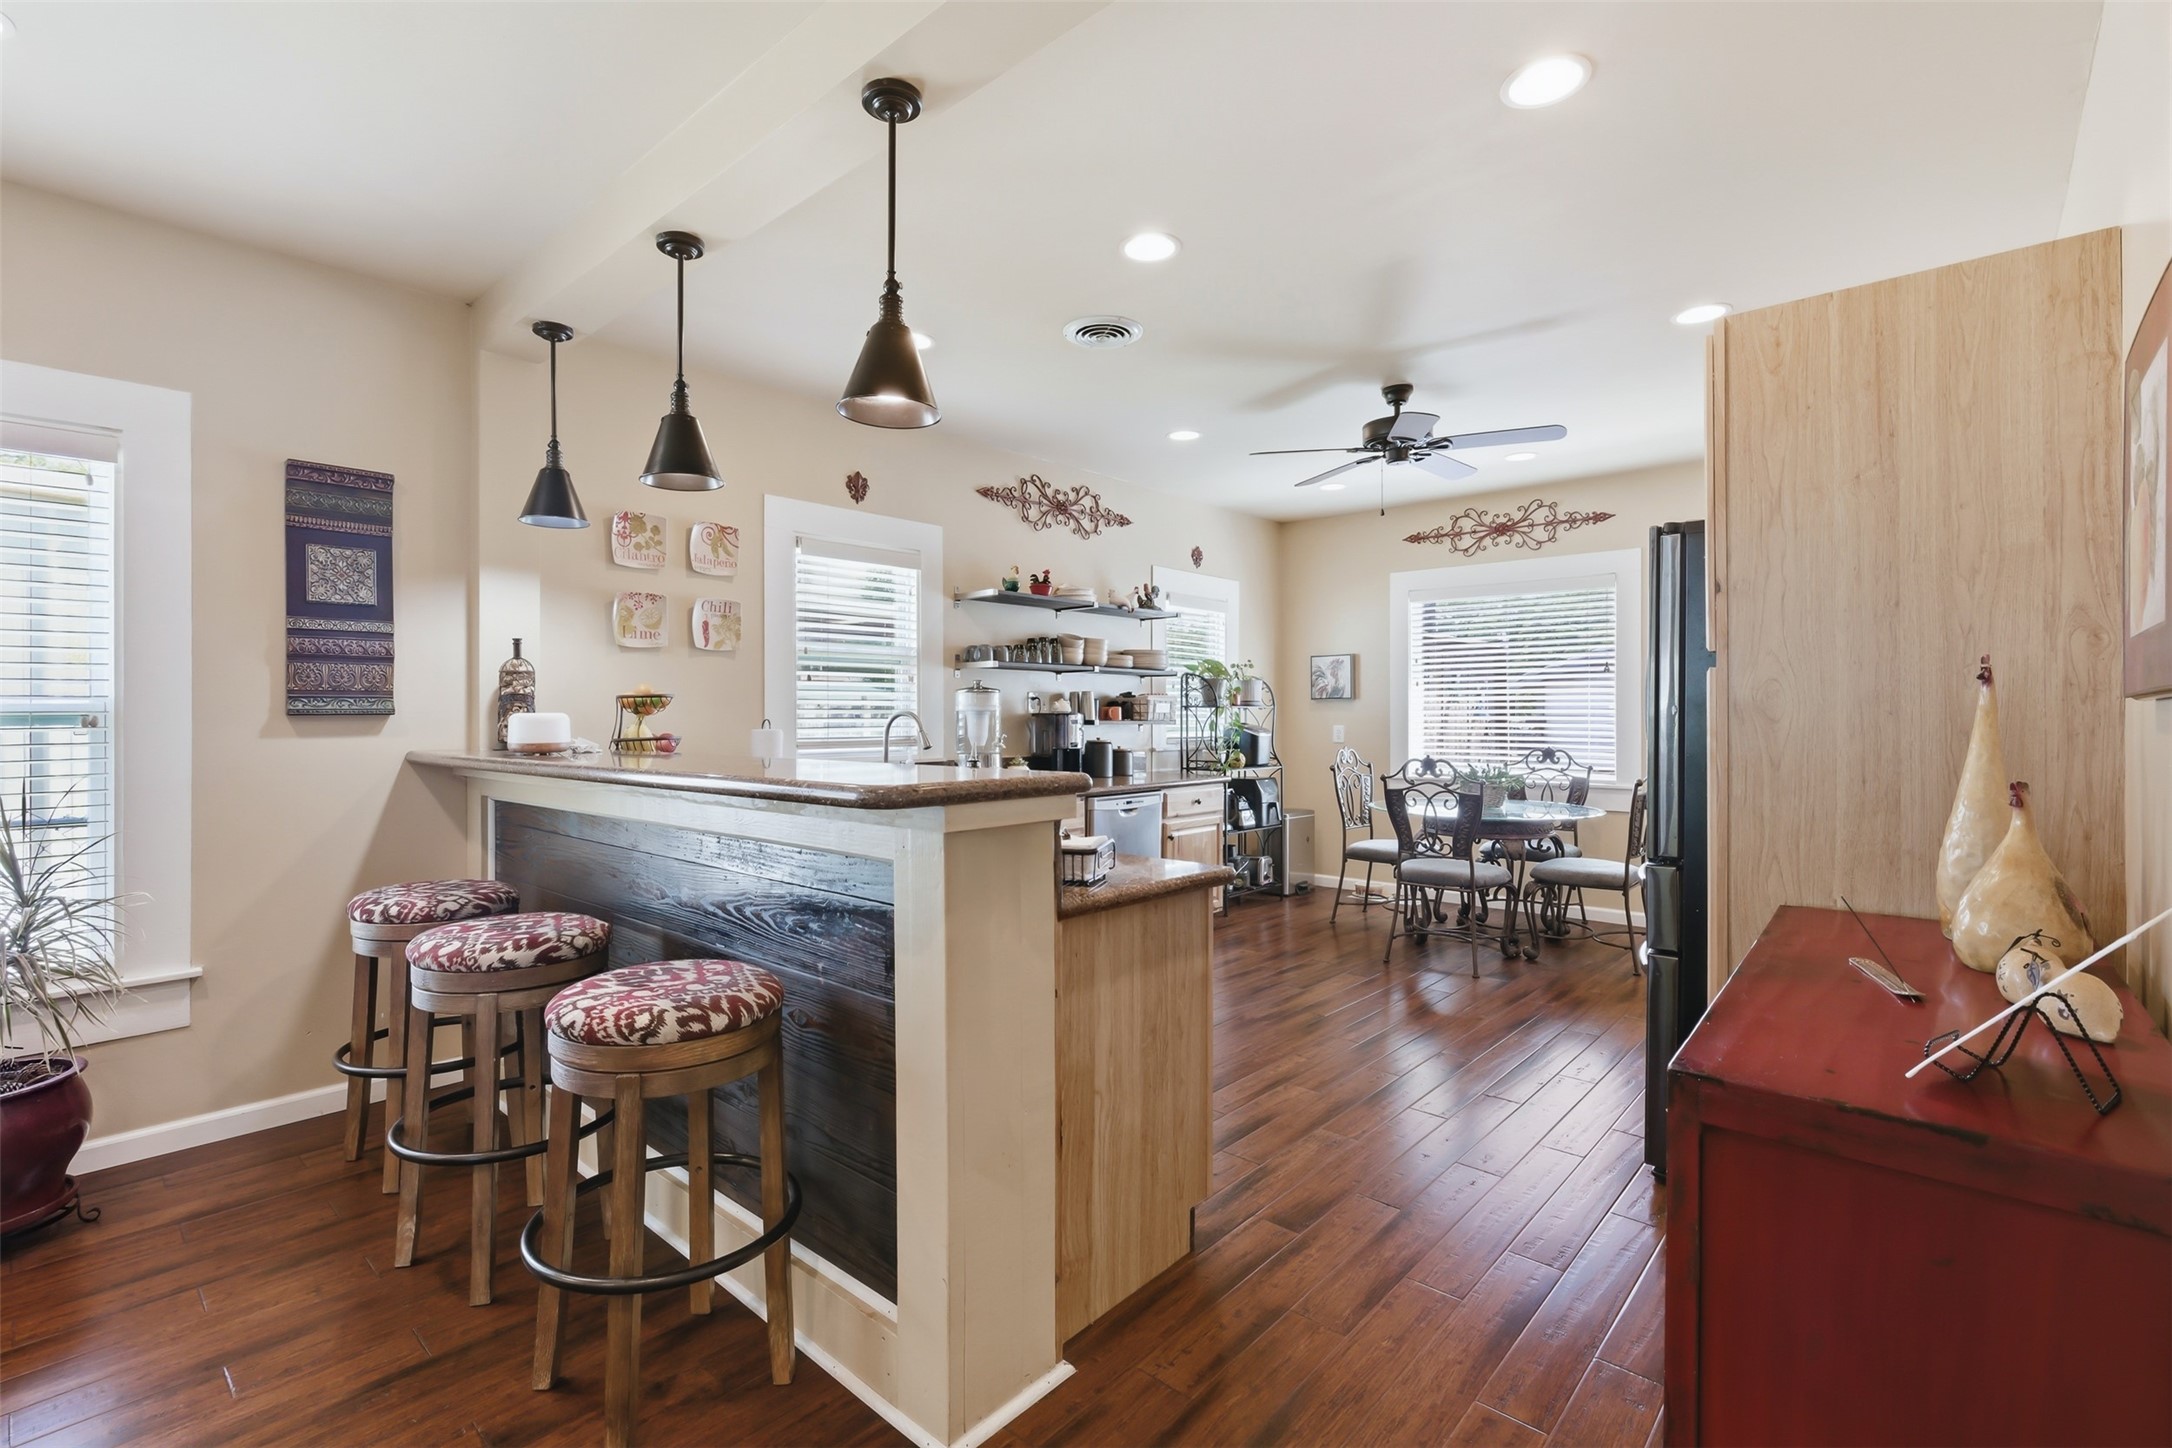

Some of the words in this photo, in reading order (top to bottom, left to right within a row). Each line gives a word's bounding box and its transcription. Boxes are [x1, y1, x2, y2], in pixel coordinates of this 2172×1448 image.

[614, 546, 666, 563] Cilantro
[691, 553, 738, 569] Jalapeño
[701, 599, 732, 614] Chili
[622, 624, 661, 641] Lime
